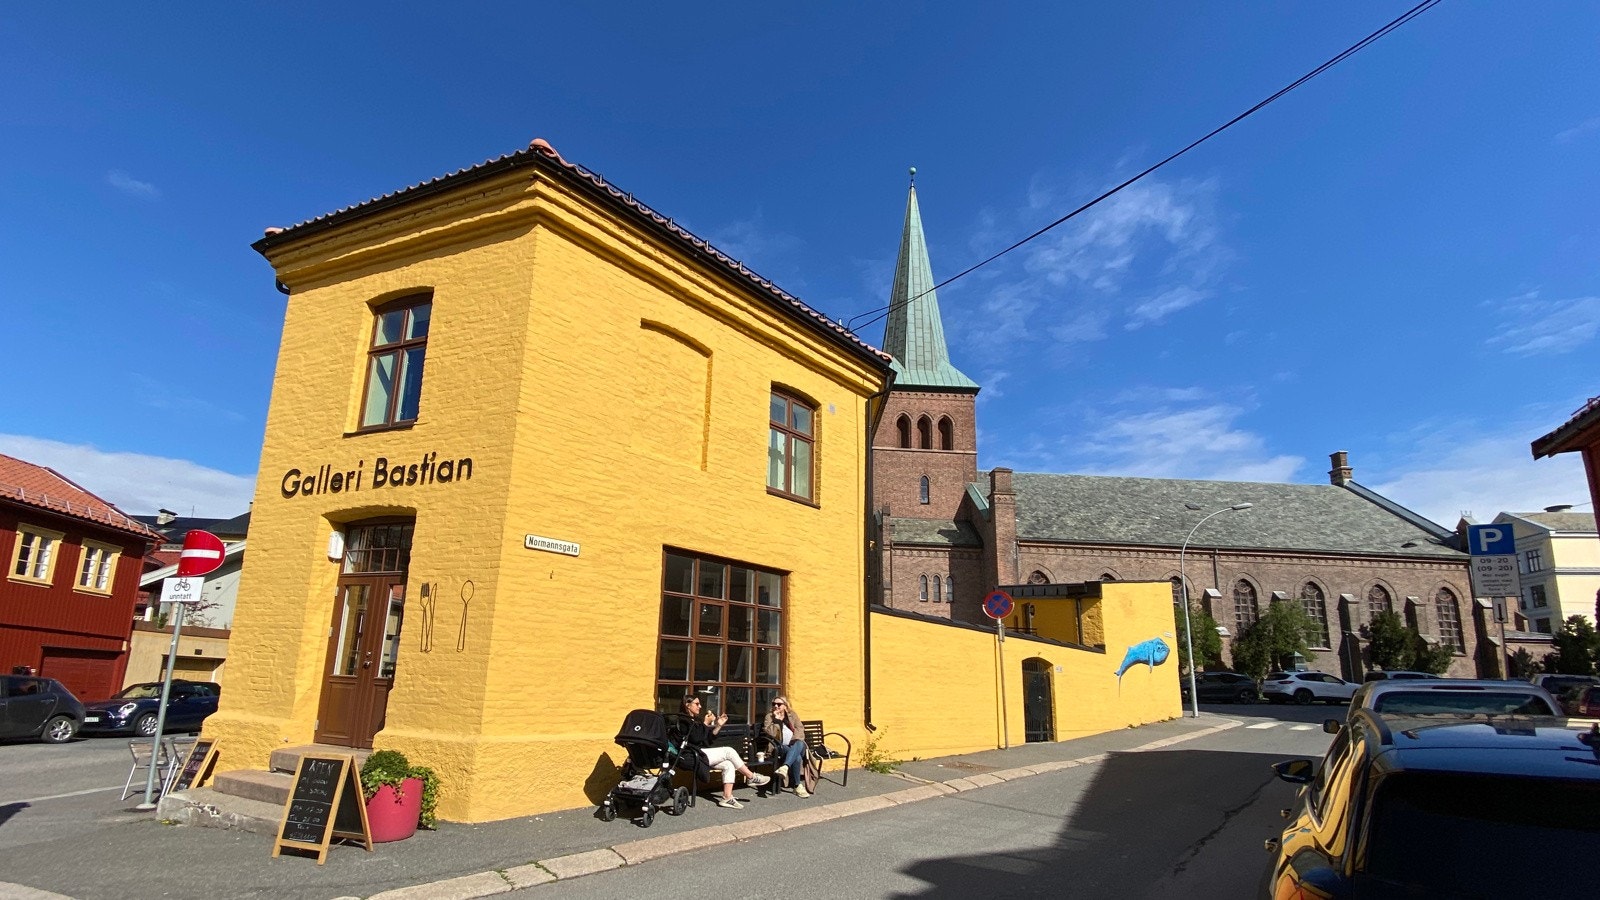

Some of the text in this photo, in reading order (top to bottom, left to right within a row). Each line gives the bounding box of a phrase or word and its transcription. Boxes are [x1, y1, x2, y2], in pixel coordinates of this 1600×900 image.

[281, 451, 473, 499] Galleri Bastian
[528, 536, 578, 553] Normannsgata
[1479, 528, 1503, 552] P
